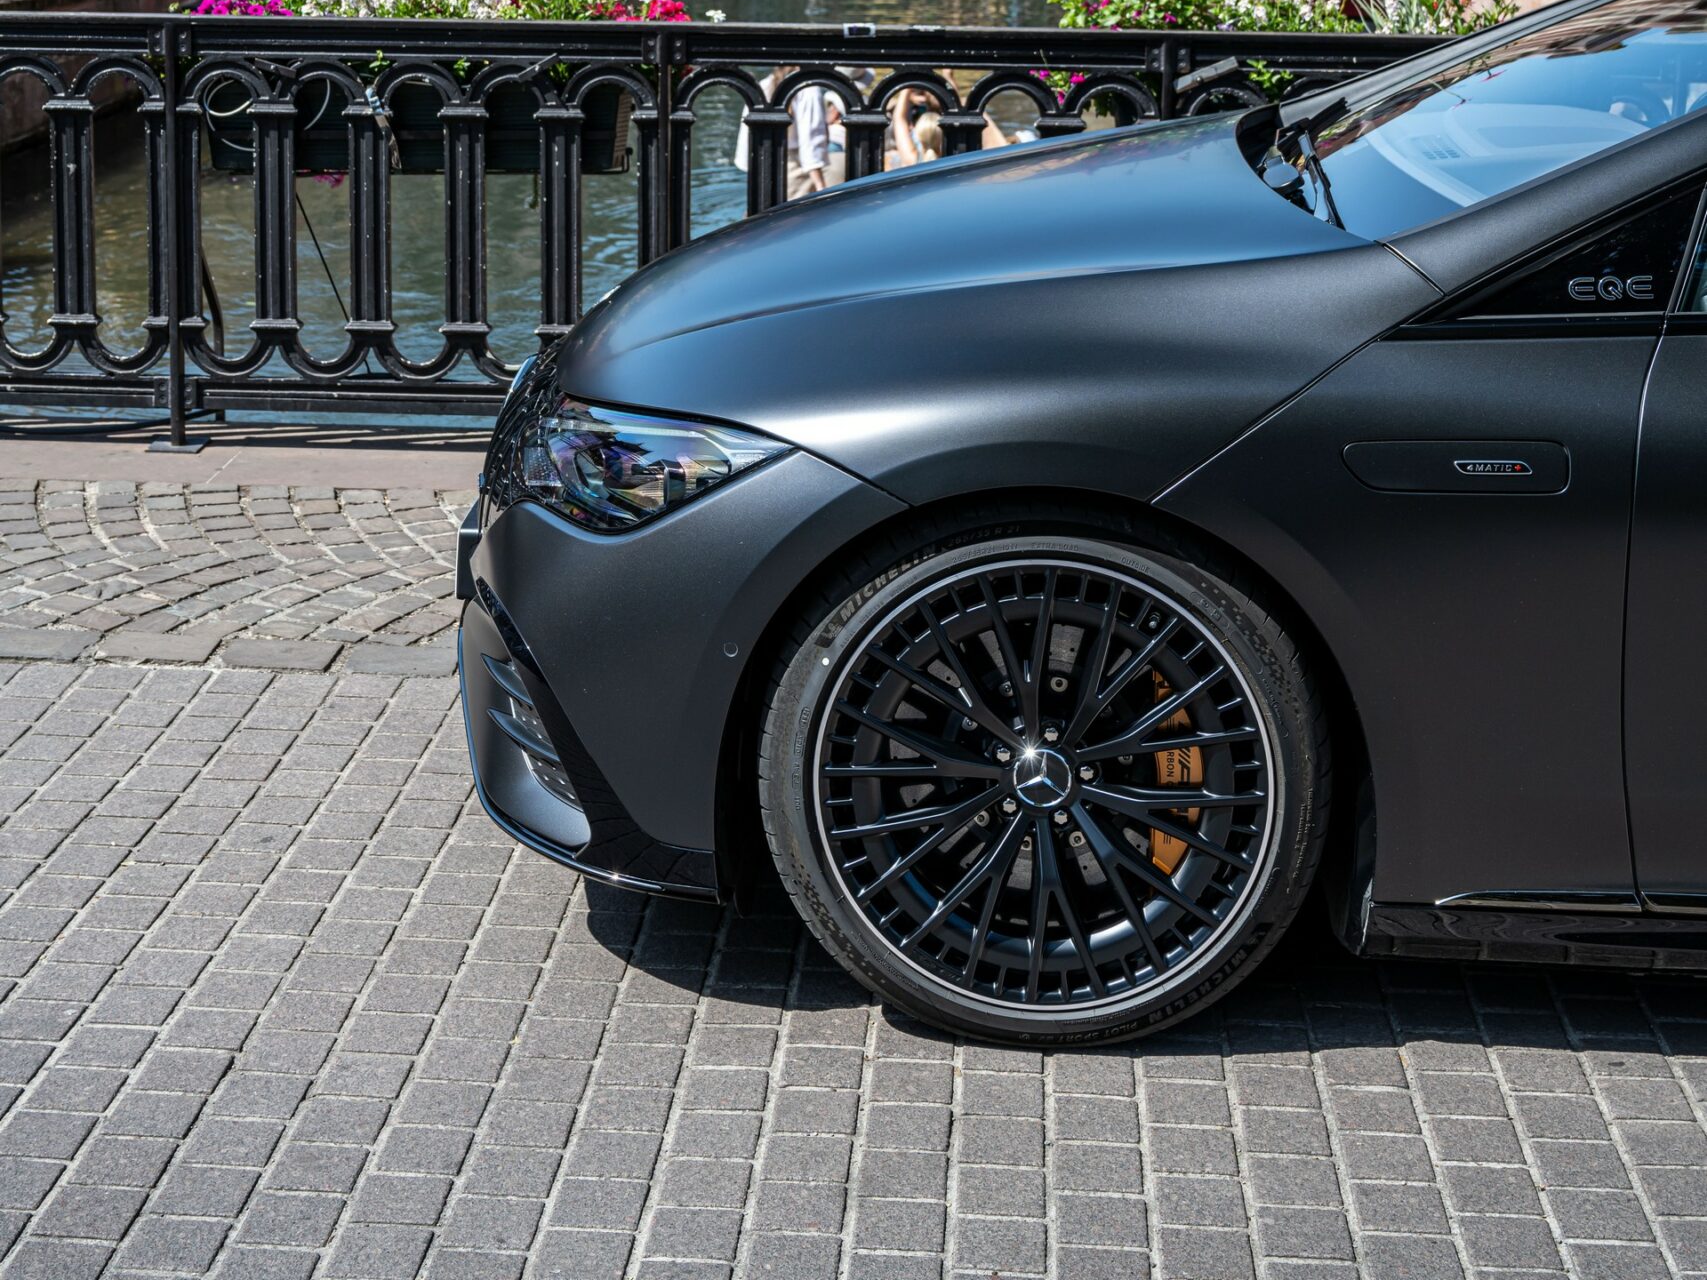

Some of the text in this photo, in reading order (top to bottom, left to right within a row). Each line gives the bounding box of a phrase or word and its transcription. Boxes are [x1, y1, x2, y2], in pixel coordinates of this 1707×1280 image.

[1568, 275, 1655, 301] EQE
[840, 544, 936, 622] MICHELIN
[1166, 752, 1175, 778] RBON
[1149, 948, 1248, 1023] MICHELIN
[1104, 1021, 1138, 1037] PILOT
